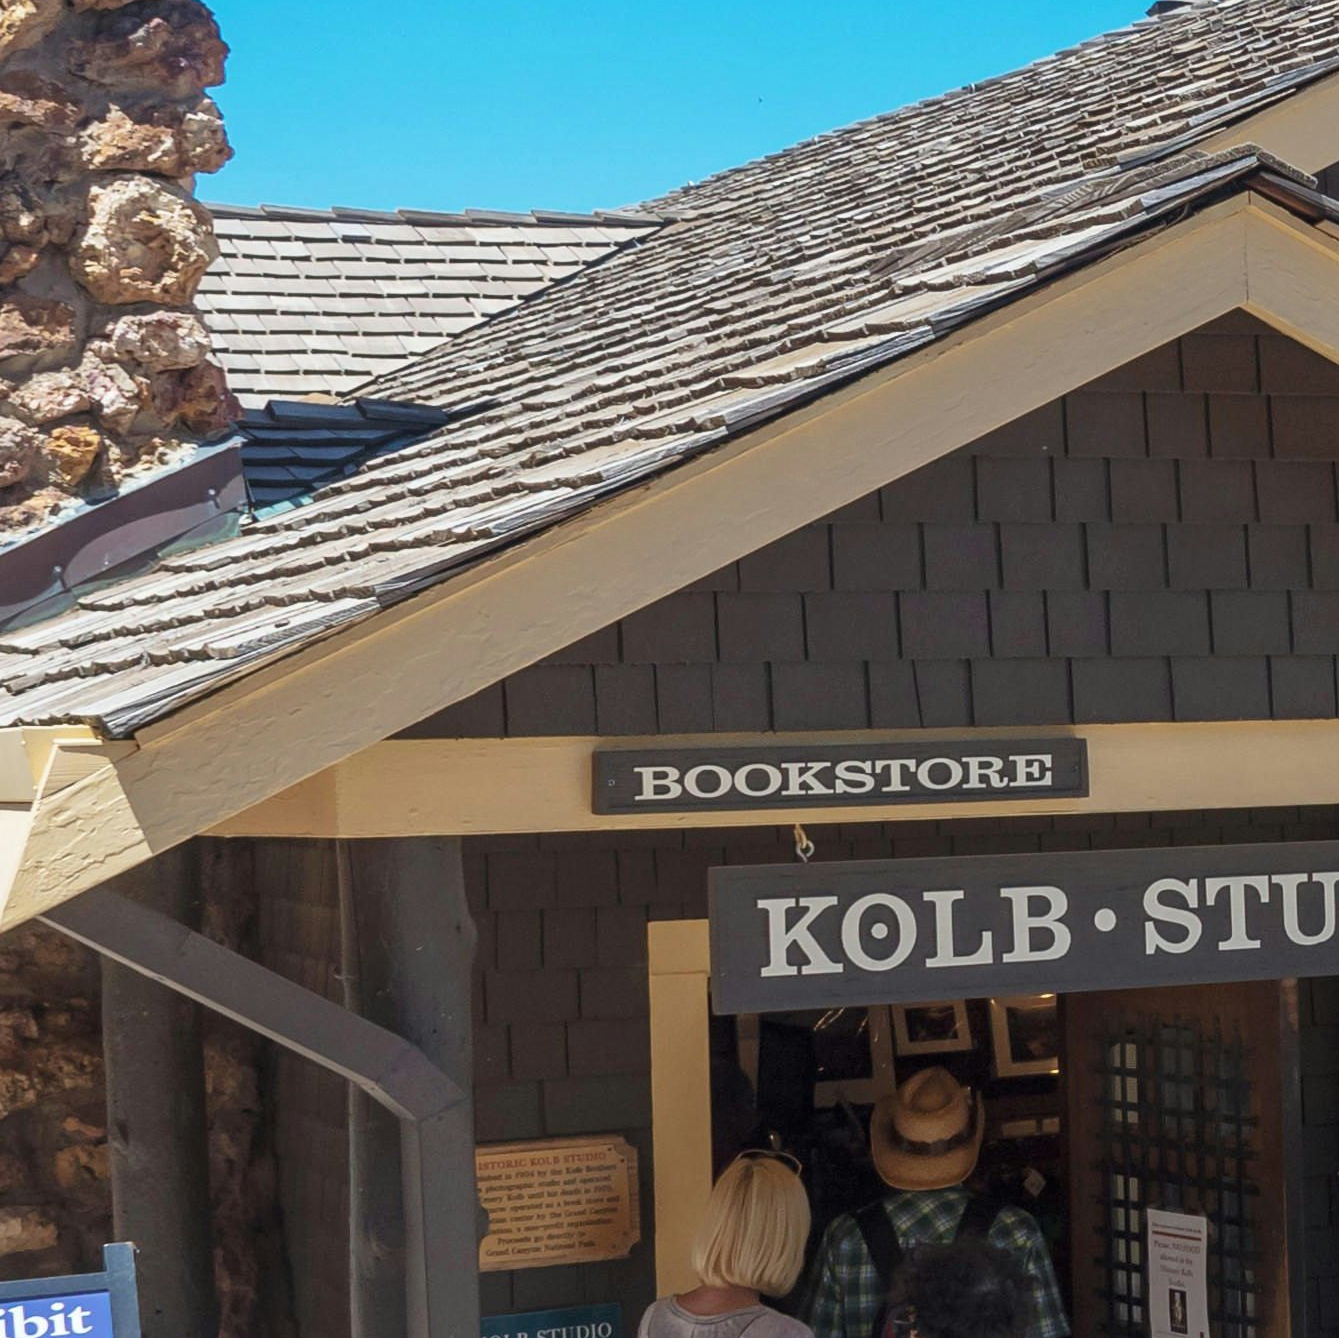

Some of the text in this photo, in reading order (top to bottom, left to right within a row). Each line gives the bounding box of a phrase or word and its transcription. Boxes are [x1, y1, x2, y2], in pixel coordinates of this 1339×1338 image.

[633, 754, 1052, 802] BOOKSTORE
[757, 886, 1071, 977] KOLB
[478, 1152, 607, 1171] ISTORIC KOLB STUDIO
